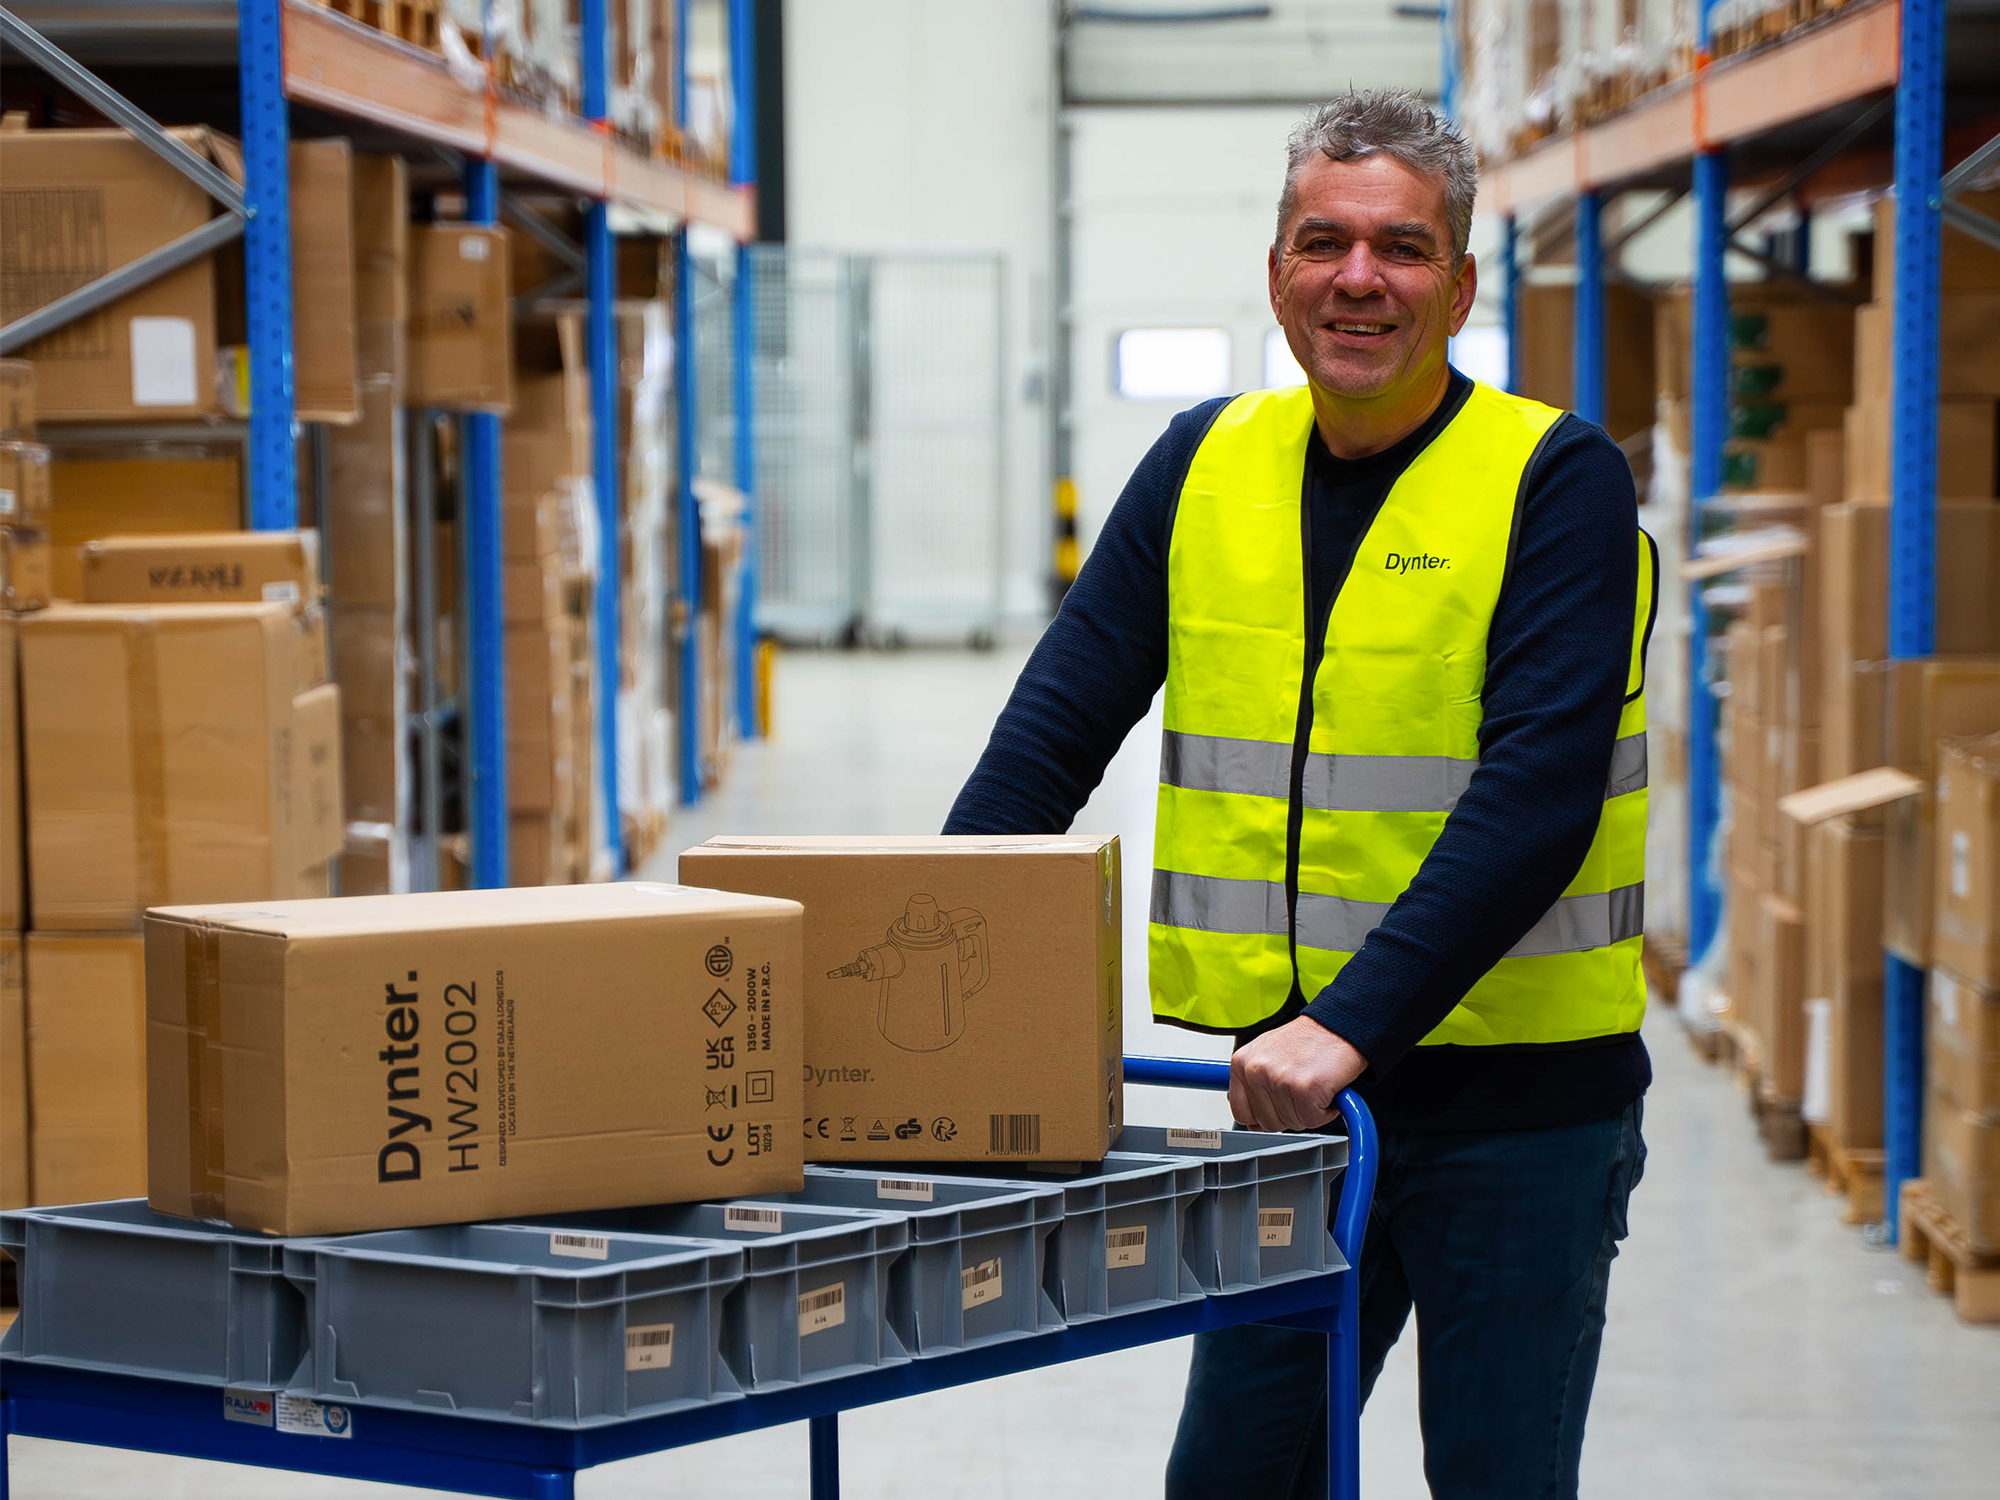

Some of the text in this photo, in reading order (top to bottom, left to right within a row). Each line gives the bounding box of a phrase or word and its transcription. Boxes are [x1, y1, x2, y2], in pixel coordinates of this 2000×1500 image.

[1385, 553, 1451, 575] Dynter.
[496, 970, 504, 1017] LOGISTICS
[747, 968, 756, 1012] 2000W
[761, 961, 771, 1050] MADE IN P.R.C.
[497, 1046, 505, 1058] BY
[706, 1038, 720, 1070] UK
[721, 1036, 735, 1068] CA
[747, 1024, 756, 1052] 1350
[378, 970, 432, 1183] Dynter.
[444, 981, 479, 1172] HW2002
[506, 999, 516, 1136] LOCATED IN THE NETHERLANDS
[803, 1064, 875, 1087] Dynter.
[707, 1124, 734, 1169] CE
[748, 1122, 760, 1156] LOT
[763, 1124, 772, 1152] 2023-9
